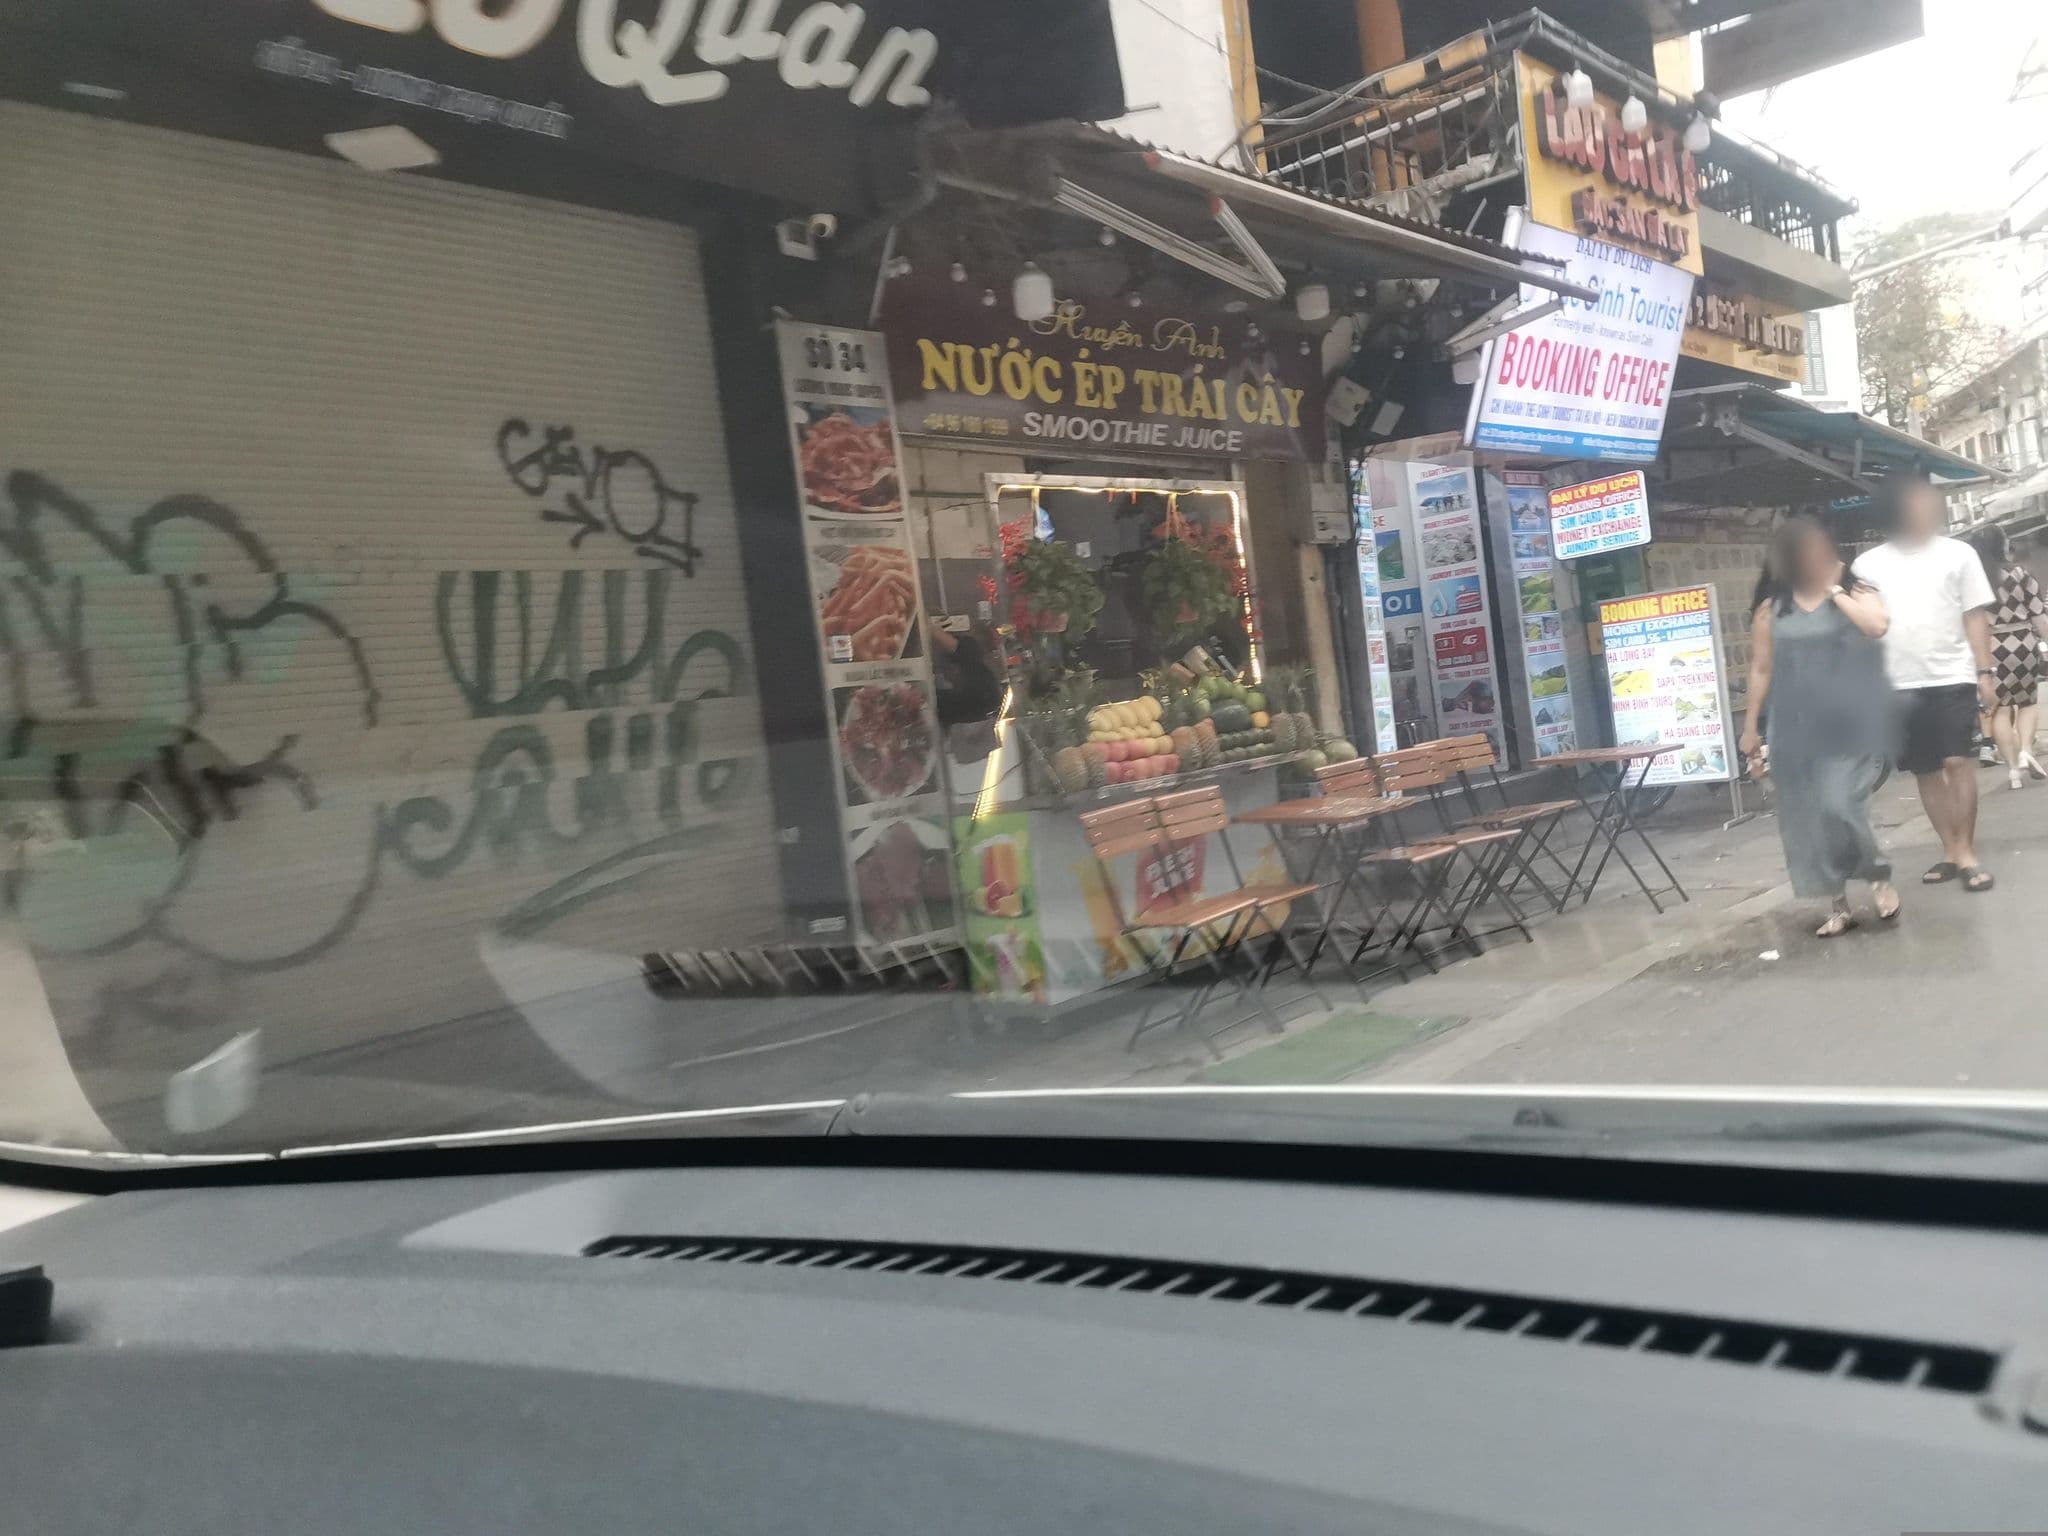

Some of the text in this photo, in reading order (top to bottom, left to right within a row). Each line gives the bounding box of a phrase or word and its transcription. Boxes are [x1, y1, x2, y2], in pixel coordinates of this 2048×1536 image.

[1627, 286, 1684, 333] Tourist
[1497, 331, 1671, 407] BOOKING OFFICE
[917, 336, 1062, 404] NƯỚC
[1133, 363, 1228, 421] TRÁI
[1235, 372, 1305, 428] CÂY
[1022, 411, 1169, 446] SMOOTHIE
[1171, 427, 1243, 452] JUICE
[1551, 488, 1642, 518] BOOKING OFFICE
[1590, 515, 1642, 538] EXCHANGE
[1600, 589, 1708, 624] BOOKING OFFICE
[1602, 612, 1711, 637] MONEY EXCHANGE
[1462, 634, 1478, 646] 4G
[1620, 648, 1640, 662] LONG
[1677, 671, 1715, 686] TREKKING
[1701, 723, 1721, 736] LOOP
[1653, 754, 1675, 767] OURS
